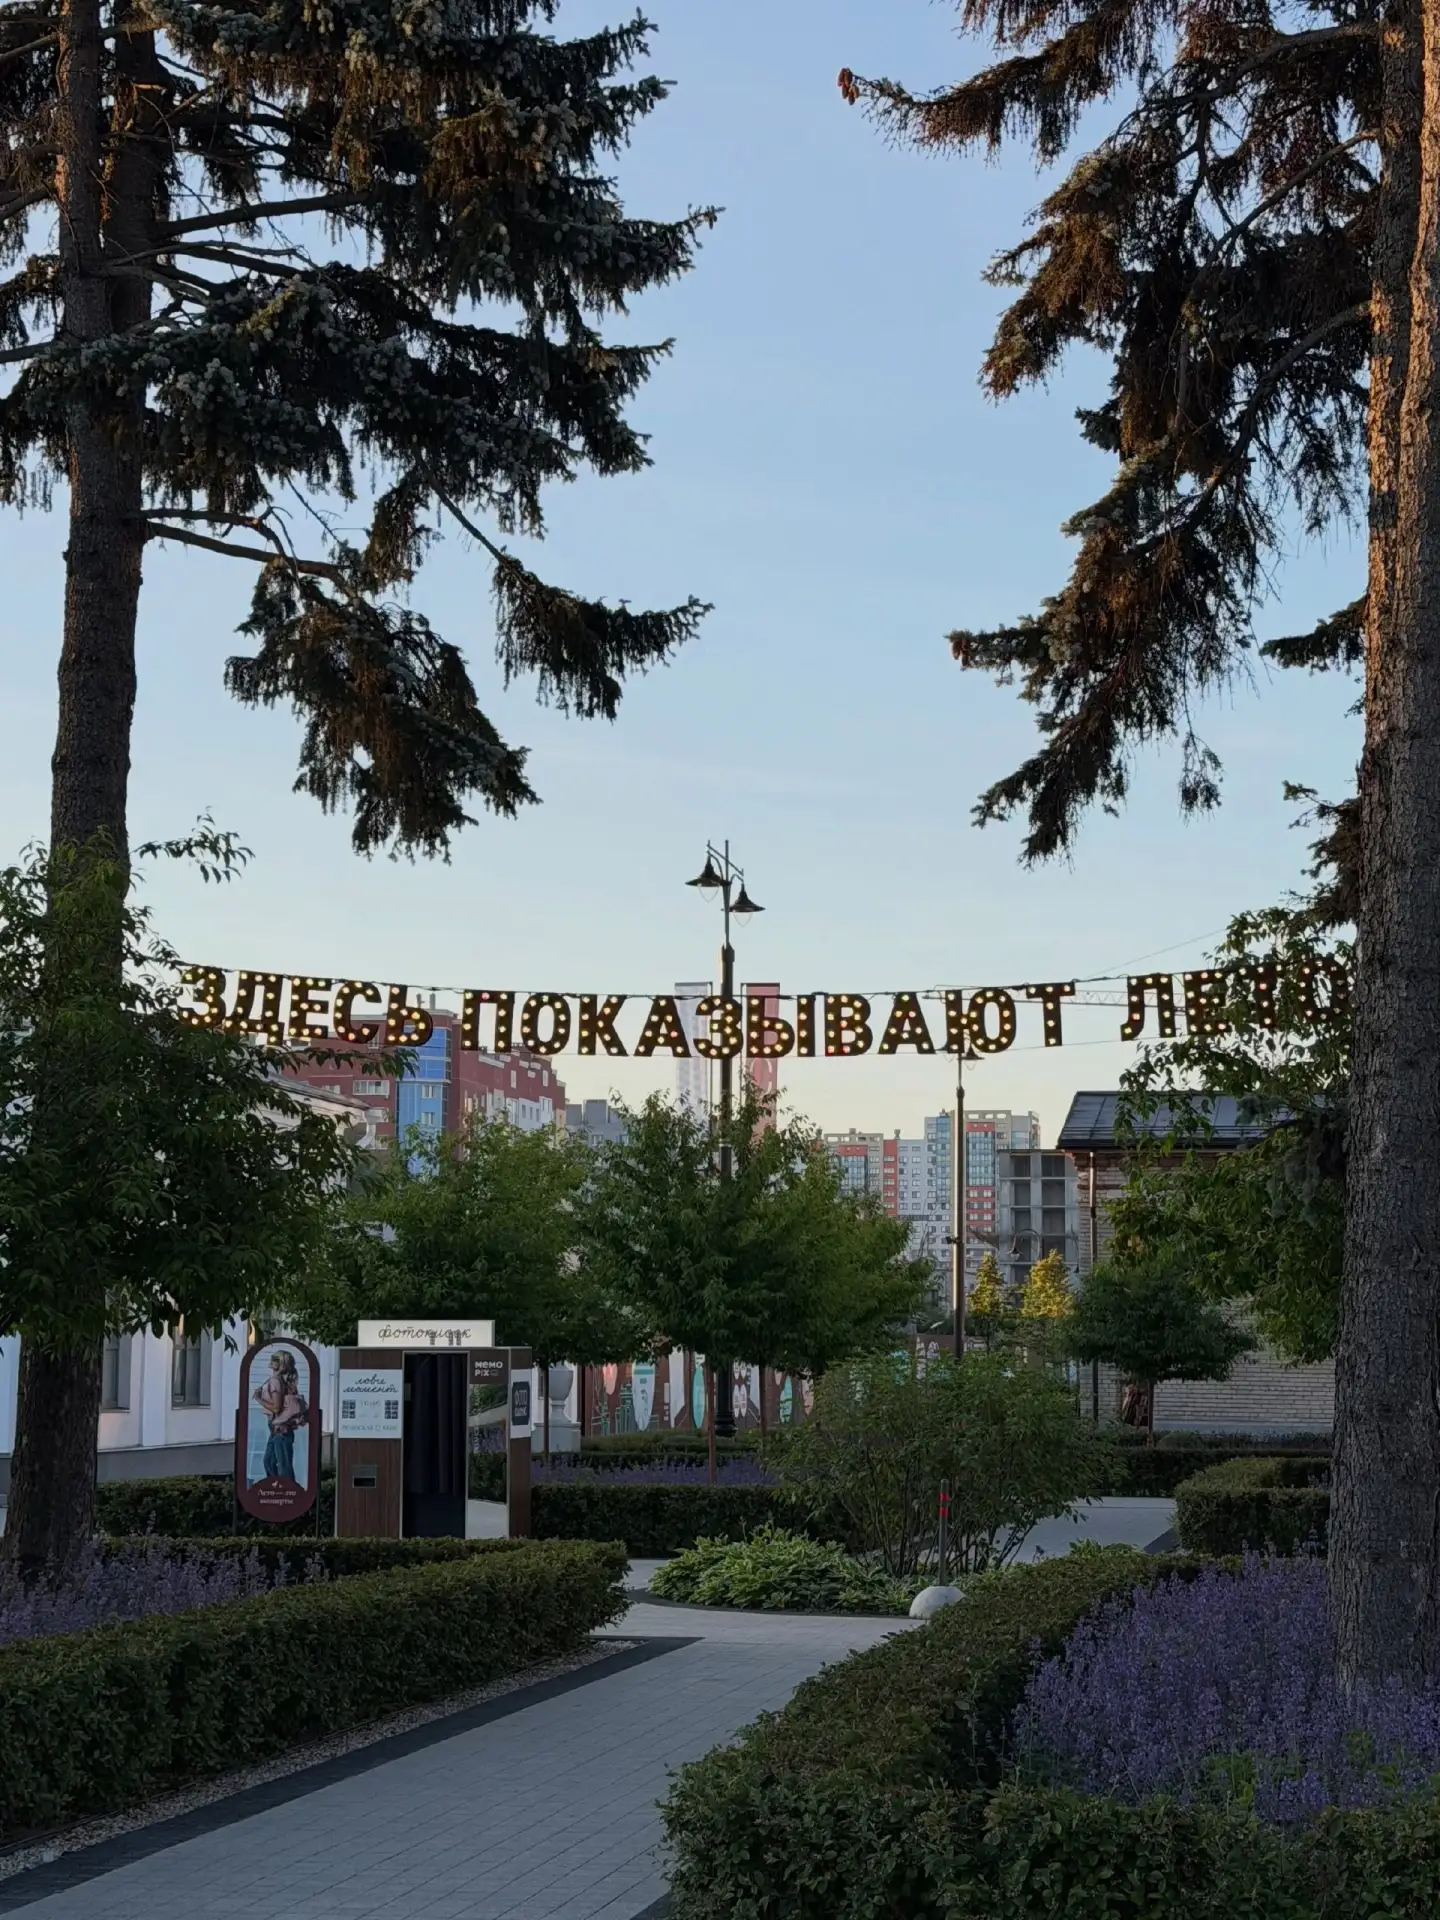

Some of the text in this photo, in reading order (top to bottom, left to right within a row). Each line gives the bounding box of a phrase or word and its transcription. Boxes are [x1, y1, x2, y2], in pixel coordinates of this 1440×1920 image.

[179, 957, 1349, 1060] ЗДЕСЬ ПОКАЗЫВАЮТ ЛЕТО
